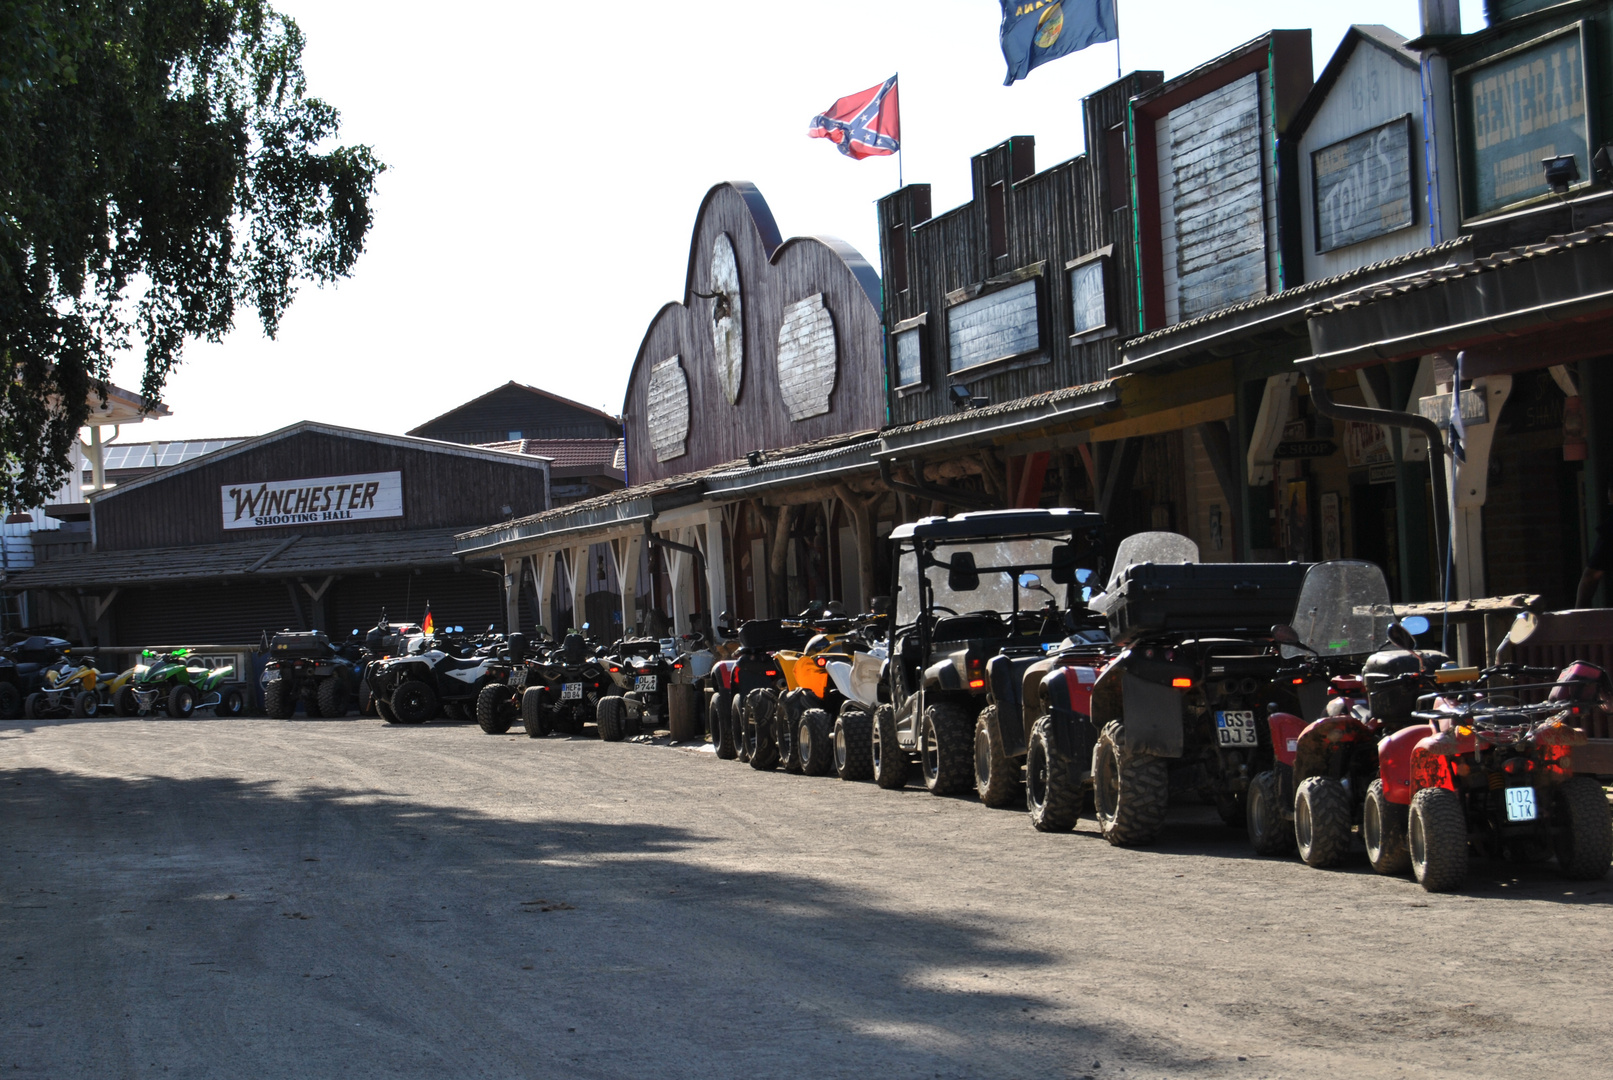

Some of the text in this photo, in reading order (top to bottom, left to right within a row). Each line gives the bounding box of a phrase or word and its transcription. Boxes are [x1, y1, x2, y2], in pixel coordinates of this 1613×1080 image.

[1473, 45, 1584, 150] GENERAL
[1324, 127, 1392, 247] TOM'S
[1290, 443, 1328, 455] SHOP
[229, 482, 379, 521] WINCHESTER
[255, 509, 353, 526] SHOOTING HALL
[1225, 713, 1243, 727] GS
[1220, 729, 1255, 743] DJ 3
[1510, 790, 1532, 804] 102
[1511, 805, 1532, 818] LTK
